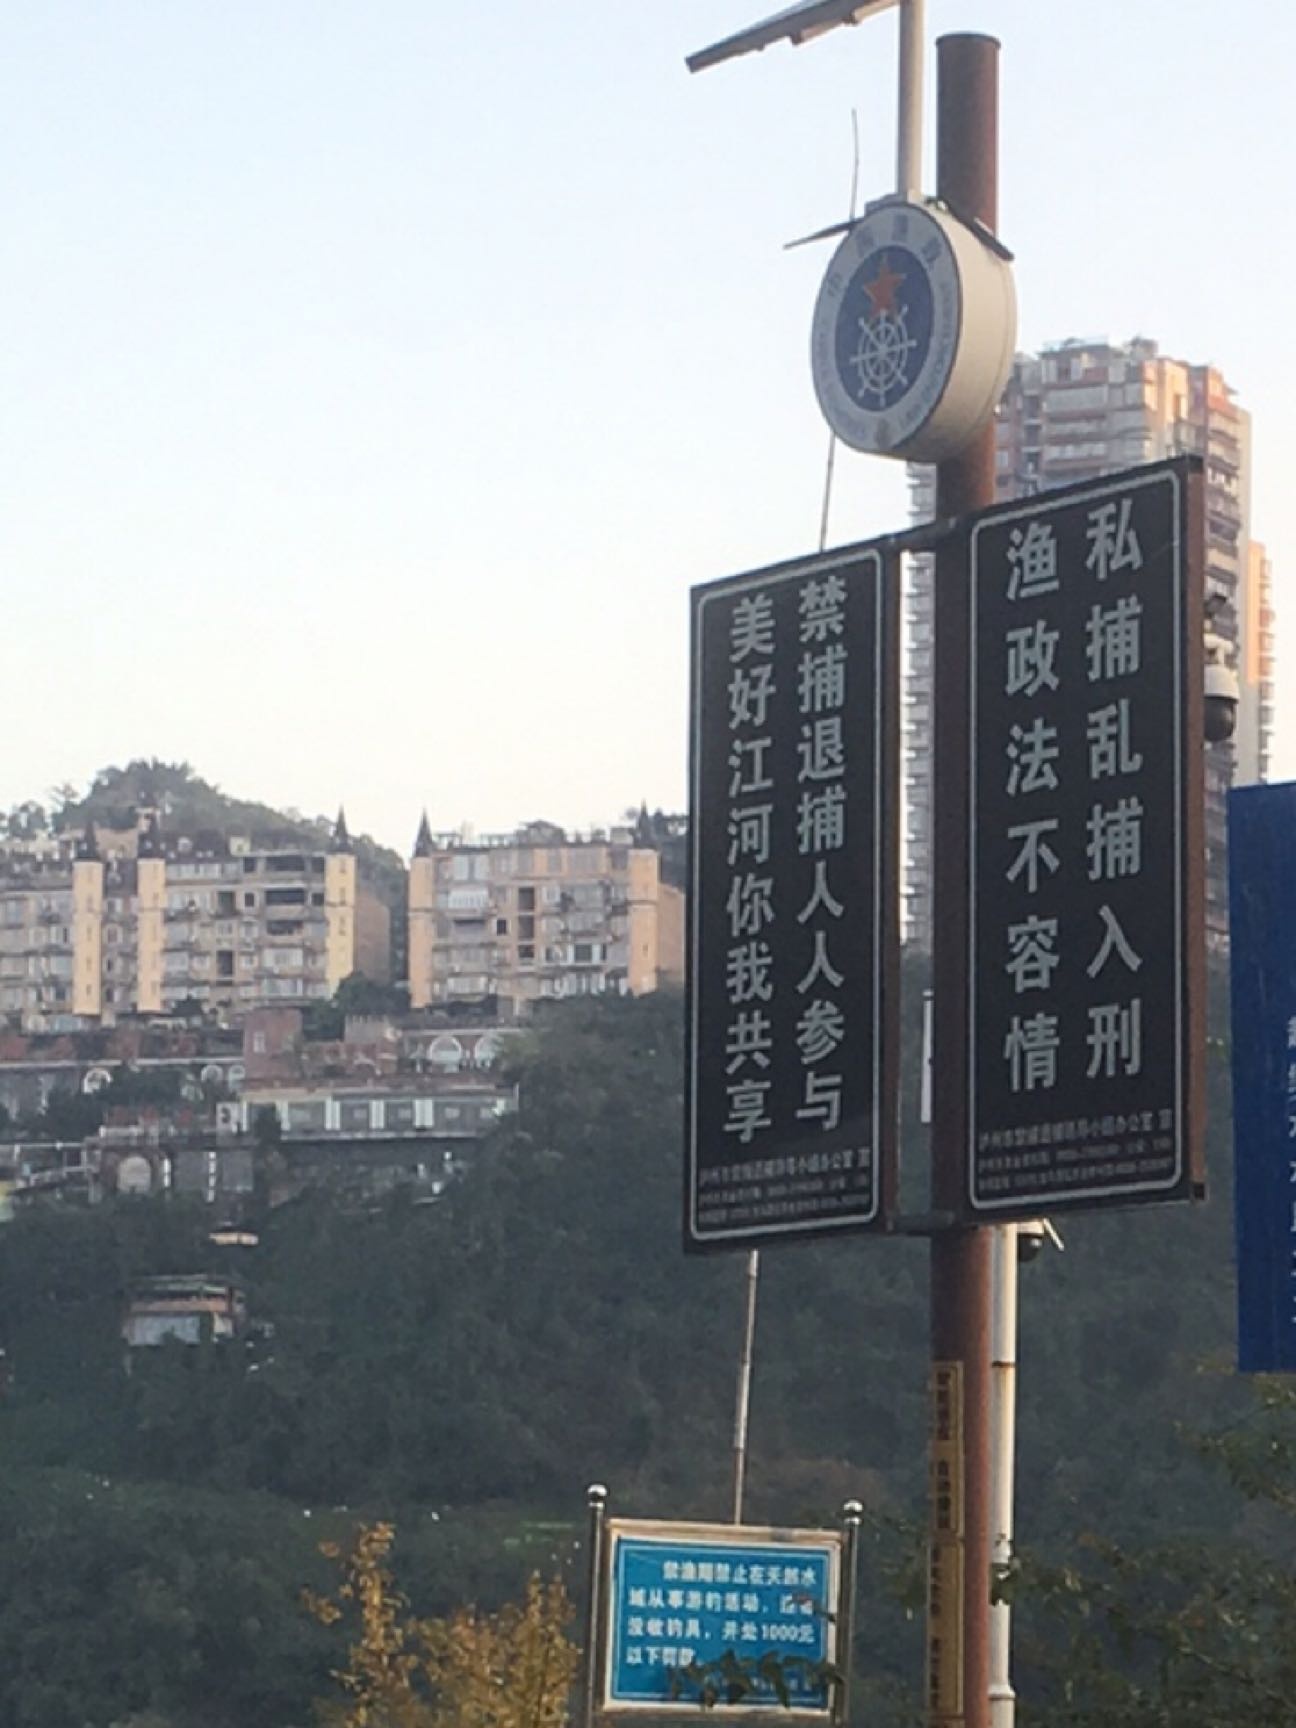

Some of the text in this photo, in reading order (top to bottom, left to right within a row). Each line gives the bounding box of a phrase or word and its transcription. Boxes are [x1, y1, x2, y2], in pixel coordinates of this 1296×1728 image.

[722, 594, 778, 1144] 美好江河你我共享
[795, 575, 848, 1133] 禁捕退捕人人参与
[1003, 521, 1061, 1093] 渔政法不容情
[1085, 497, 1144, 1080] 私捕乱捕入刑
